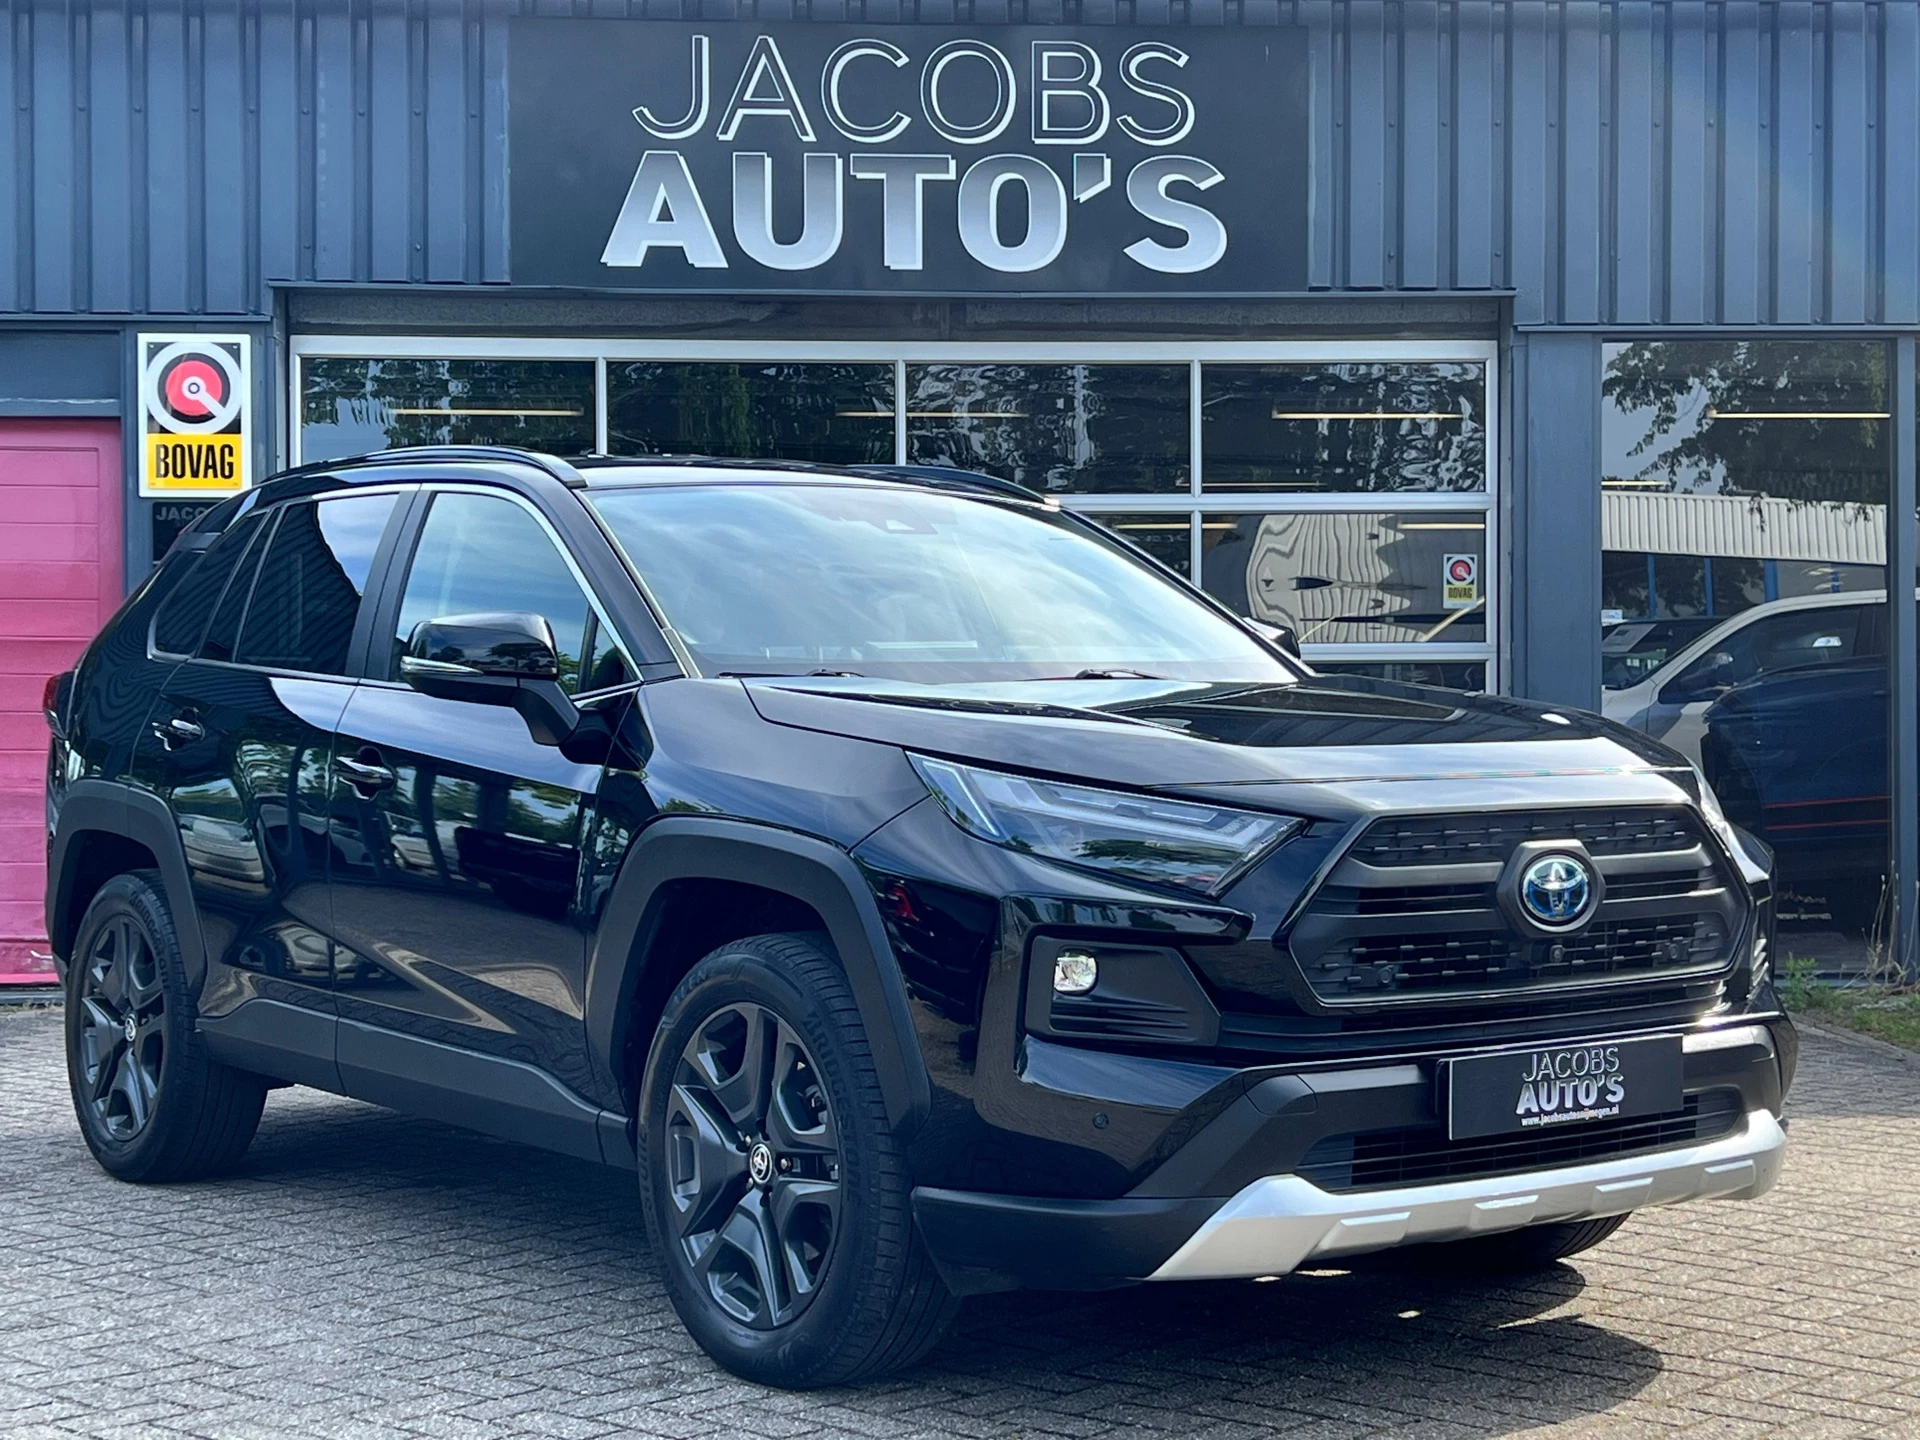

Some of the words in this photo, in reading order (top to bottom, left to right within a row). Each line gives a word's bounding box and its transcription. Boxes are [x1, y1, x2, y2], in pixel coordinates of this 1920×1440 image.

[631, 34, 1196, 146] JACOBS
[600, 150, 1228, 274] AUTO'S
[155, 443, 234, 479] BOVAG
[1521, 1046, 1620, 1081] JACOBS
[1515, 1073, 1625, 1115] AUTO'S
